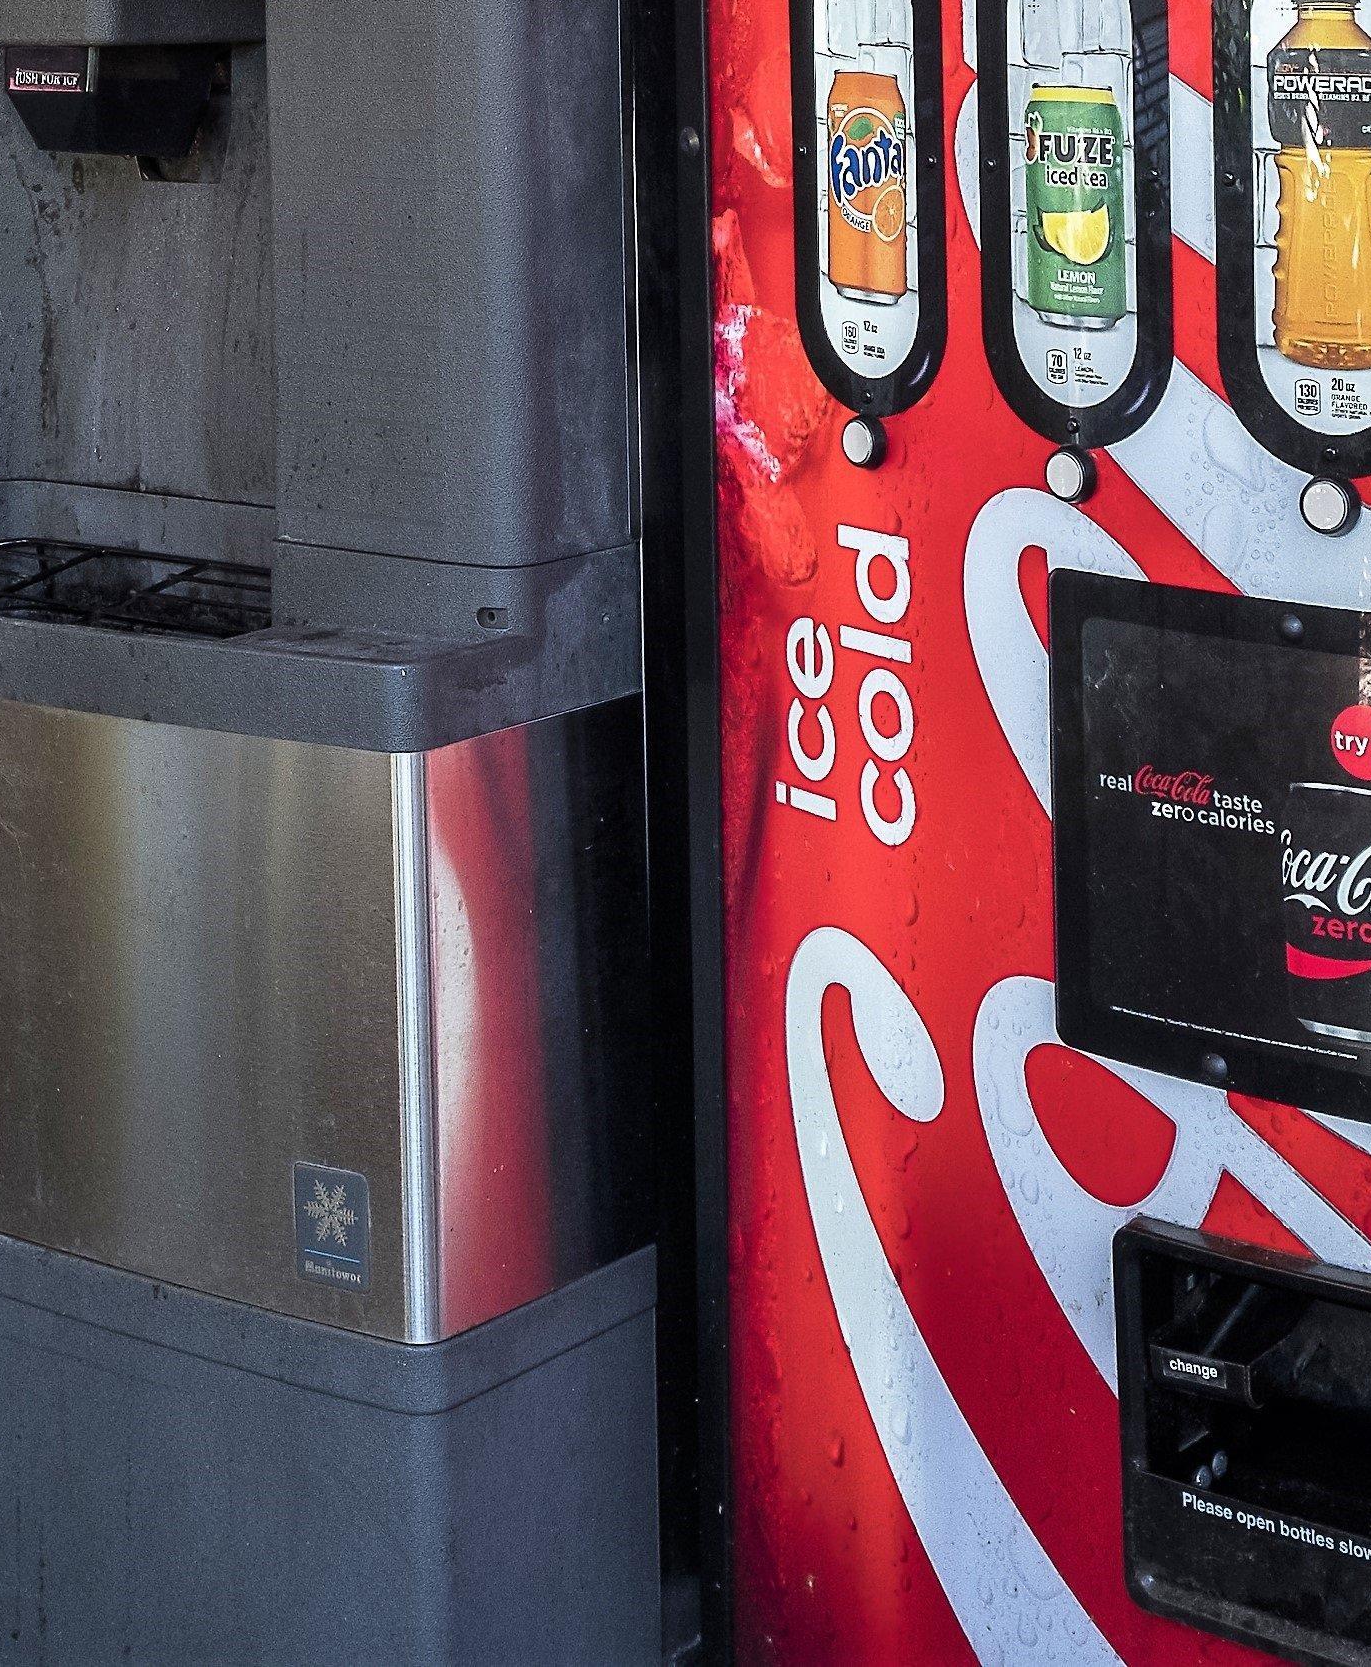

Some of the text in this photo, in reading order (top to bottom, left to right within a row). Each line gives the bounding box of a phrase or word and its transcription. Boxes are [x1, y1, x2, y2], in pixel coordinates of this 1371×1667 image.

[1039, 134, 1113, 166] FUZE
[831, 130, 903, 206] Fanta
[1047, 166, 1107, 187] iced tea
[843, 203, 870, 230] ORANGE
[1058, 270, 1095, 284] LEMON
[1052, 354, 1062, 367] 70
[1074, 348, 1081, 359] 12
[1299, 378, 1355, 397] 130 20 oz
[1332, 401, 1367, 410] FLAVORED
[837, 524, 916, 846] cold
[776, 617, 837, 822] ice
[1335, 731, 1368, 756] try
[1100, 765, 1262, 813] real Coca-Cola taste
[1152, 802, 1275, 834] zero calories
[305, 1260, 361, 1283] Manitowoc
[1169, 1357, 1218, 1379] change
[1183, 1492, 1232, 1521] Please
[1236, 1510, 1275, 1533] open
[1280, 1520, 1335, 1551] bottles
